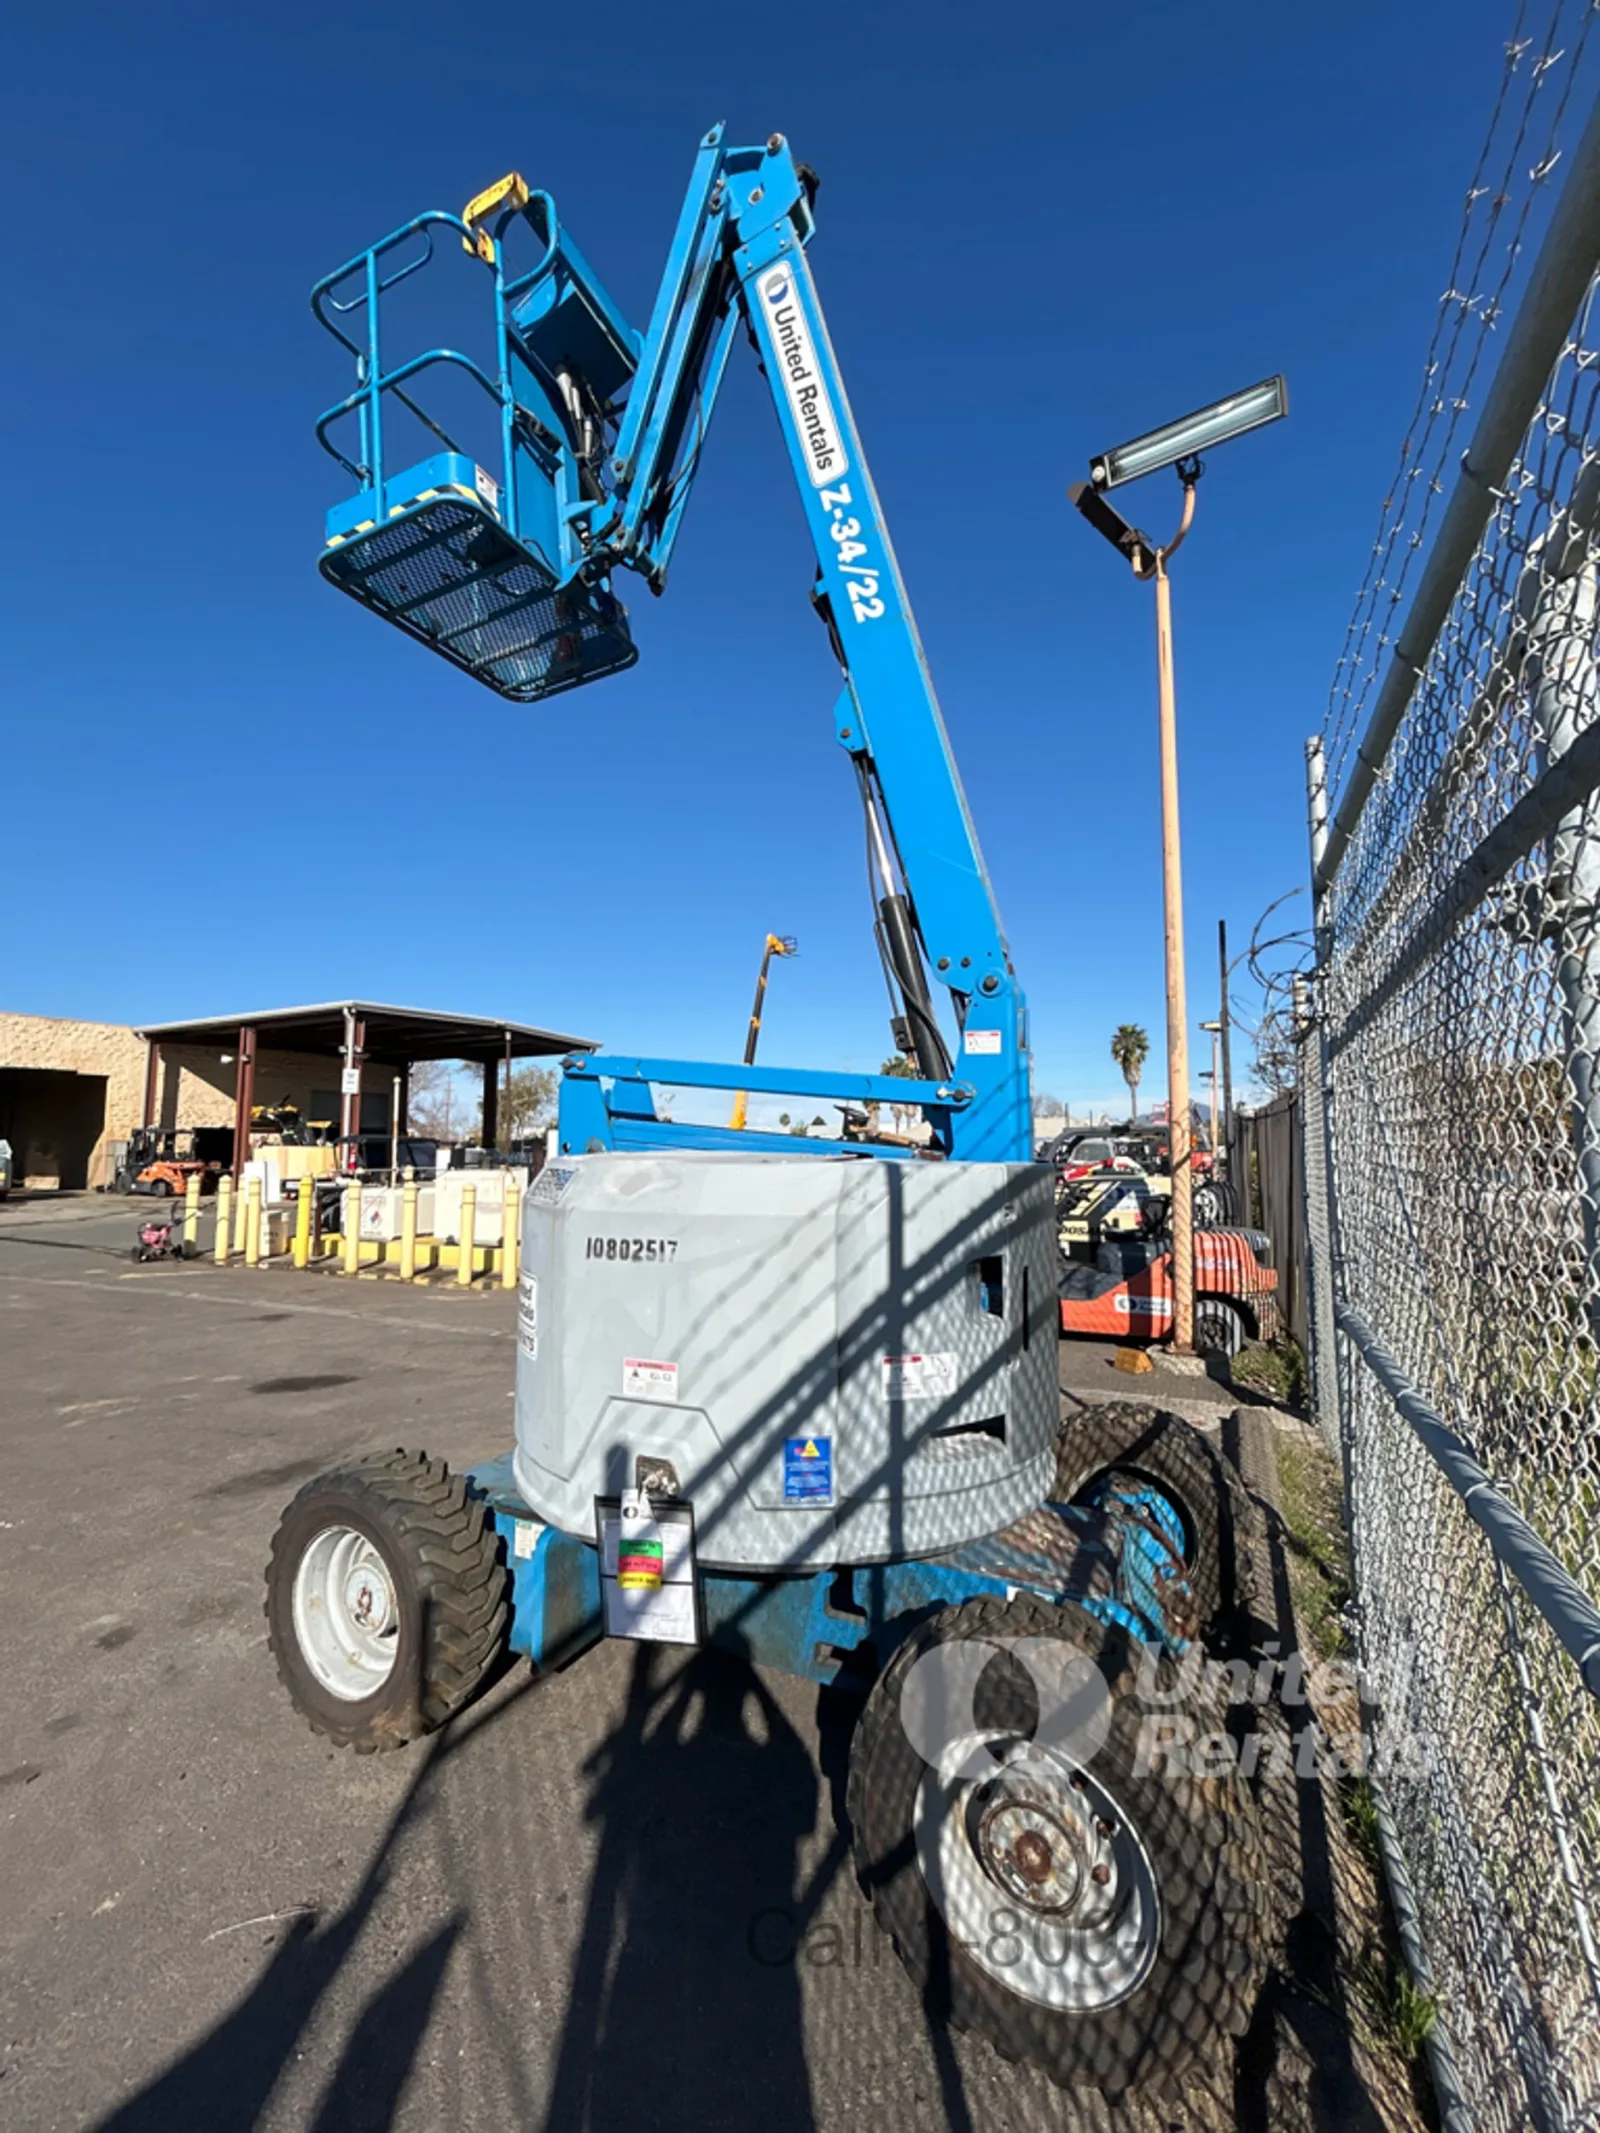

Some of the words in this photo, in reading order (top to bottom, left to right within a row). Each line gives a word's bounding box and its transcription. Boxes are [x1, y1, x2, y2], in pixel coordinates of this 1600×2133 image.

[774, 304, 812, 382] United
[796, 382, 833, 471] Rentals
[819, 483, 885, 624] Z-34/22
[586, 1237, 678, 1263] 10802517
